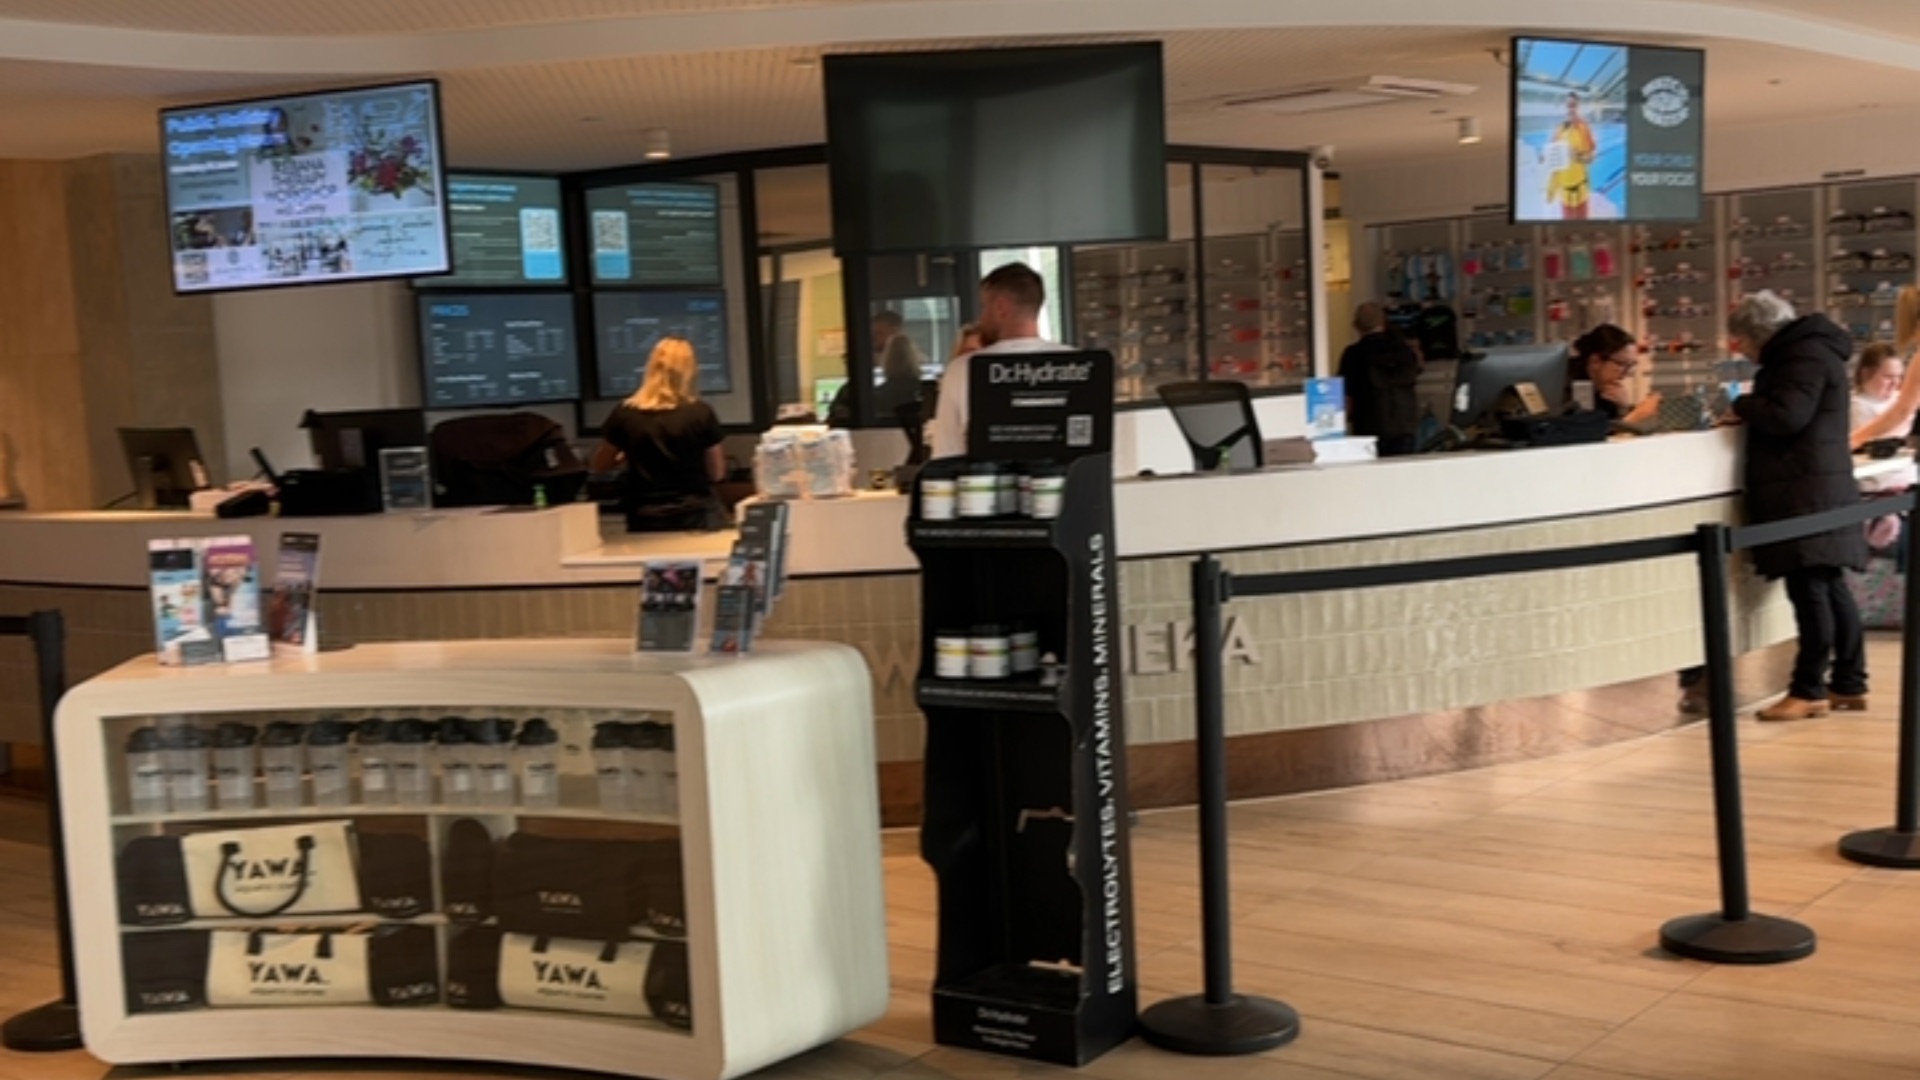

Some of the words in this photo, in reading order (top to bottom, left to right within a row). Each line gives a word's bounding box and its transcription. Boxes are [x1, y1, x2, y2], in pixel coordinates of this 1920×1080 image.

[1630, 171, 1660, 187] YOUR
[1088, 533, 1109, 665] MINERALS
[247, 962, 324, 985] YAWA
[533, 960, 604, 990] YAWA
